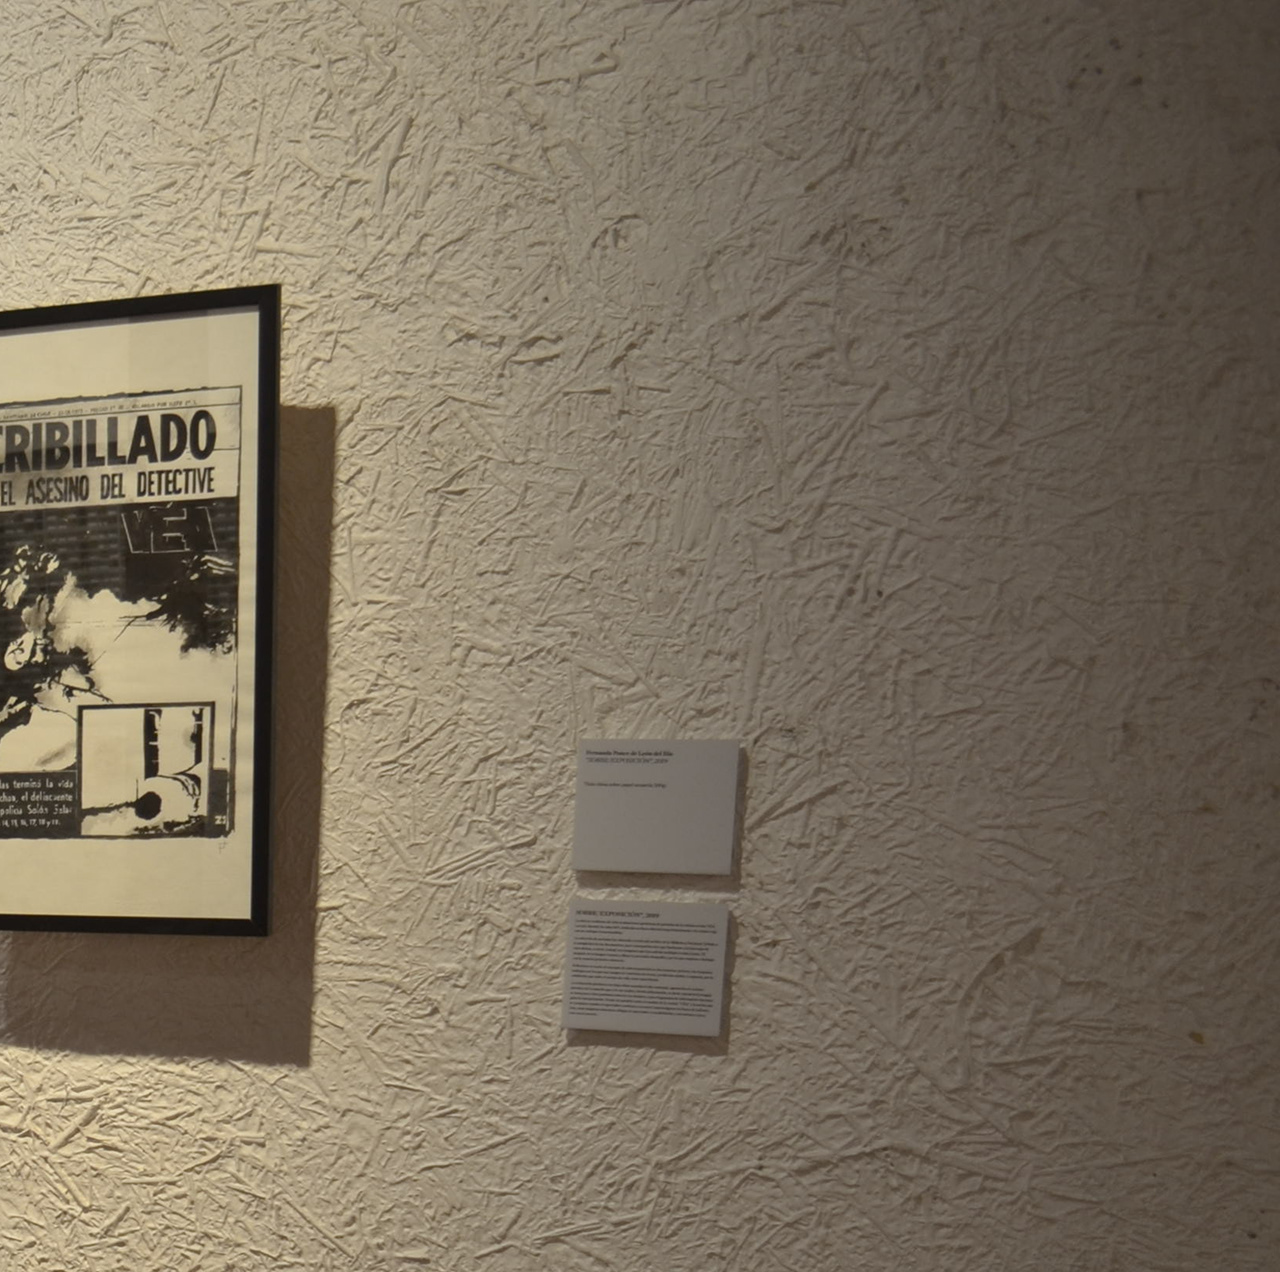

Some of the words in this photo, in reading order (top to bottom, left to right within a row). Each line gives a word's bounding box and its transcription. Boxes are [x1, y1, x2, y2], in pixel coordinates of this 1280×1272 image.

[0, 481, 16, 506] EL
[25, 475, 90, 505] ASESINO
[100, 473, 126, 500] DEL
[137, 466, 216, 498] DETECTIVE
[46, 778, 54, 789] la
[58, 779, 73, 789] vida
[21, 791, 28, 802] el
